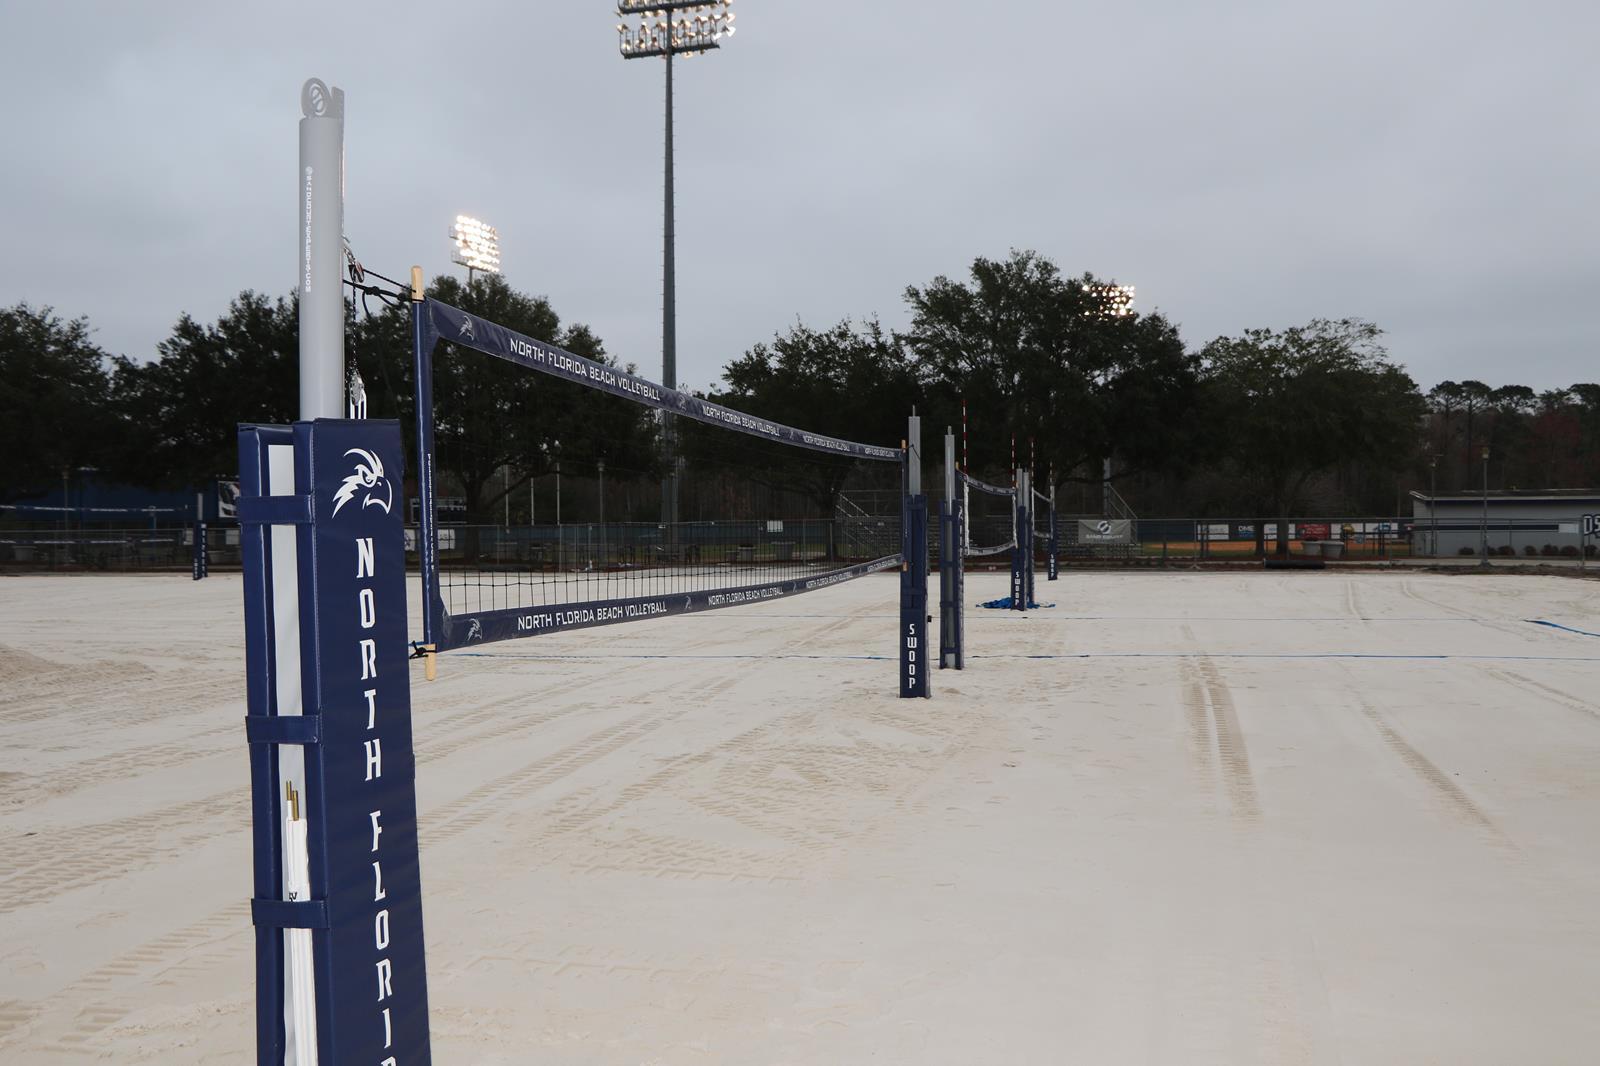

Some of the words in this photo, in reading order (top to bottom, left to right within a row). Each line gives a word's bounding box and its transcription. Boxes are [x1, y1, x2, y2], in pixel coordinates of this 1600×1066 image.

[510, 338, 545, 363] NORTH
[548, 352, 587, 377] FLORIDA
[589, 366, 616, 386] BEACH
[617, 377, 661, 401] VOLLEYBALL
[702, 404, 721, 420] NORTH
[517, 613, 553, 631] NORTH
[556, 609, 595, 626] FLORIDA
[597, 606, 624, 621] BEACH
[625, 601, 668, 617] VOLLEYBALL
[708, 594, 725, 607] NORTH
[726, 592, 745, 604] FLORIDA
[745, 590, 760, 601] BEACH
[760, 586, 784, 599] VOLLEYBALL
[907, 622, 917, 689] SWOOP
[356, 537, 382, 782] NORTH
[369, 809, 397, 1066] FLORI
